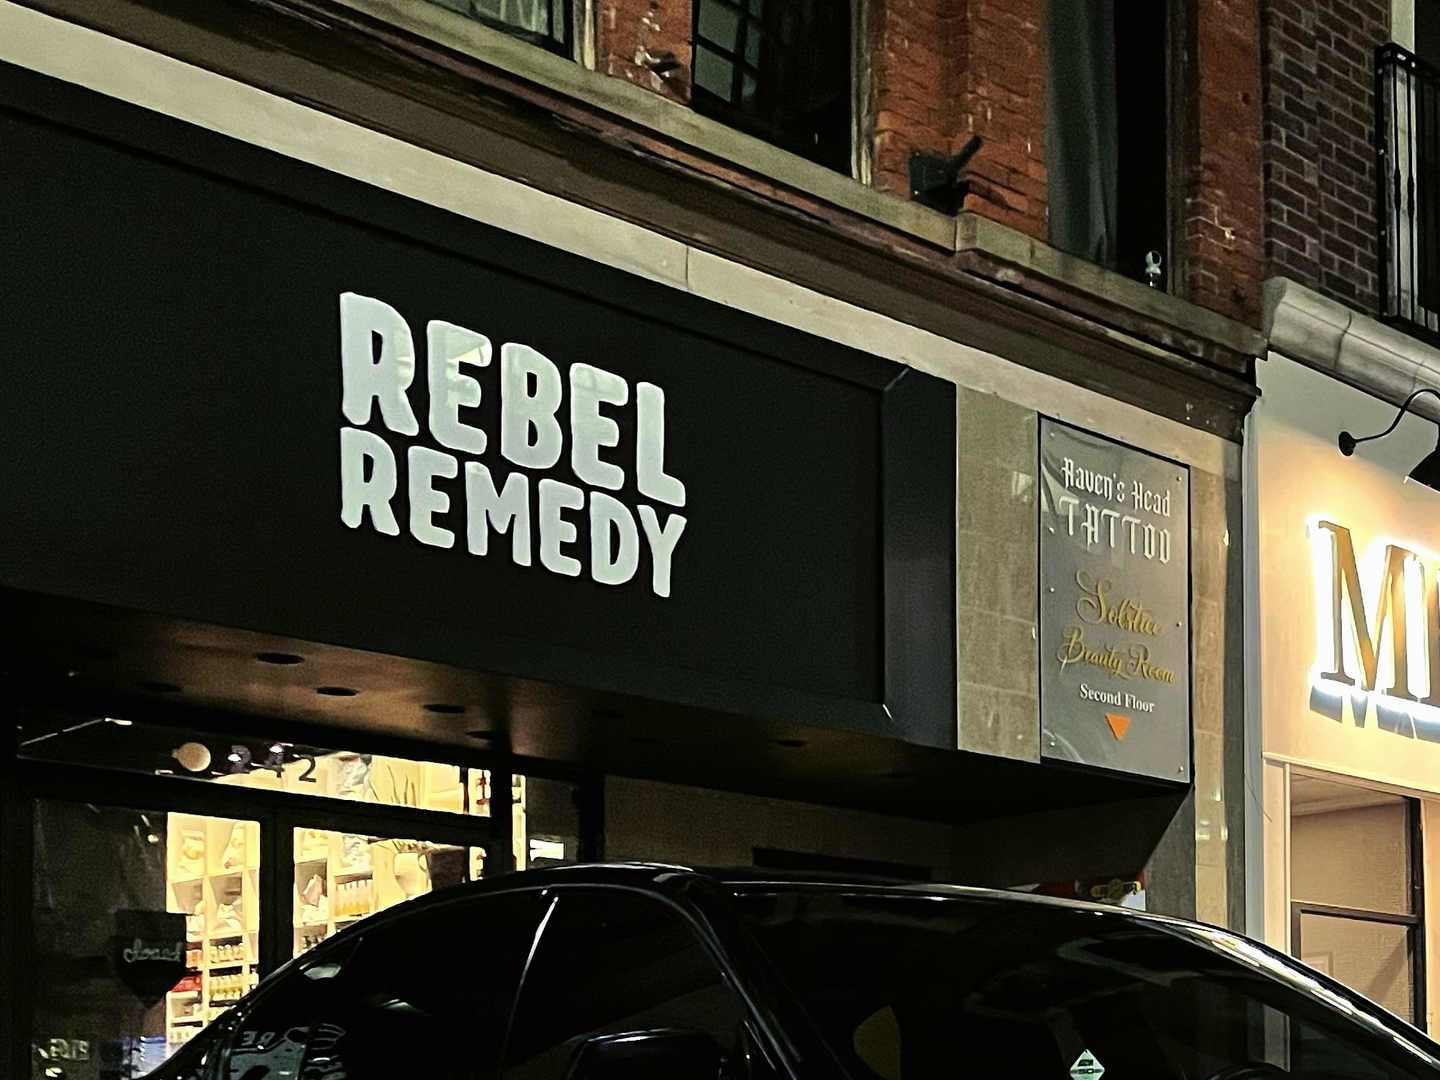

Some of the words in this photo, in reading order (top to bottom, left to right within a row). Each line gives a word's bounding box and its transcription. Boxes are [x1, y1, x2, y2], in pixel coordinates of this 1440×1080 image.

[340, 292, 687, 507] REBEL
[340, 426, 687, 598] REMEDY
[1061, 457, 1125, 502] Raven's
[1131, 480, 1170, 517] Head
[1059, 496, 1170, 564] TATTOO
[1080, 683, 1121, 706] Second
[1125, 693, 1155, 712] Floor
